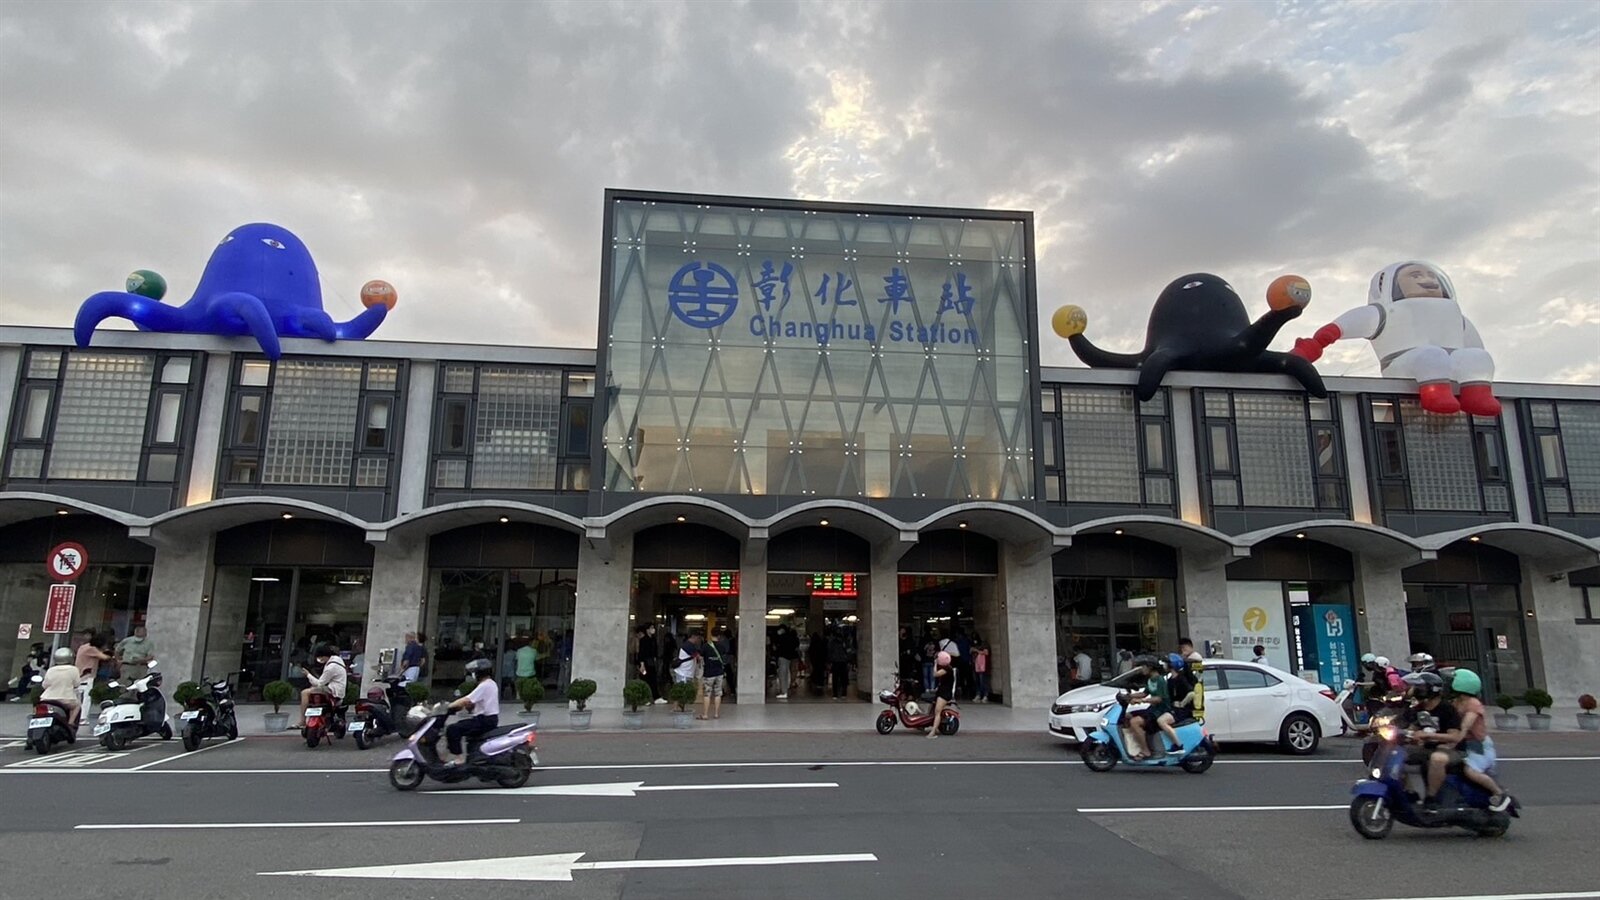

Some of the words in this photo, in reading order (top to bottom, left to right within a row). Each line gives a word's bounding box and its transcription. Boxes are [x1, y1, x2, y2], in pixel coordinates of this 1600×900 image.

[751, 259, 975, 315] 彰化車站
[750, 315, 875, 346] Changhua
[889, 320, 977, 344] Station
